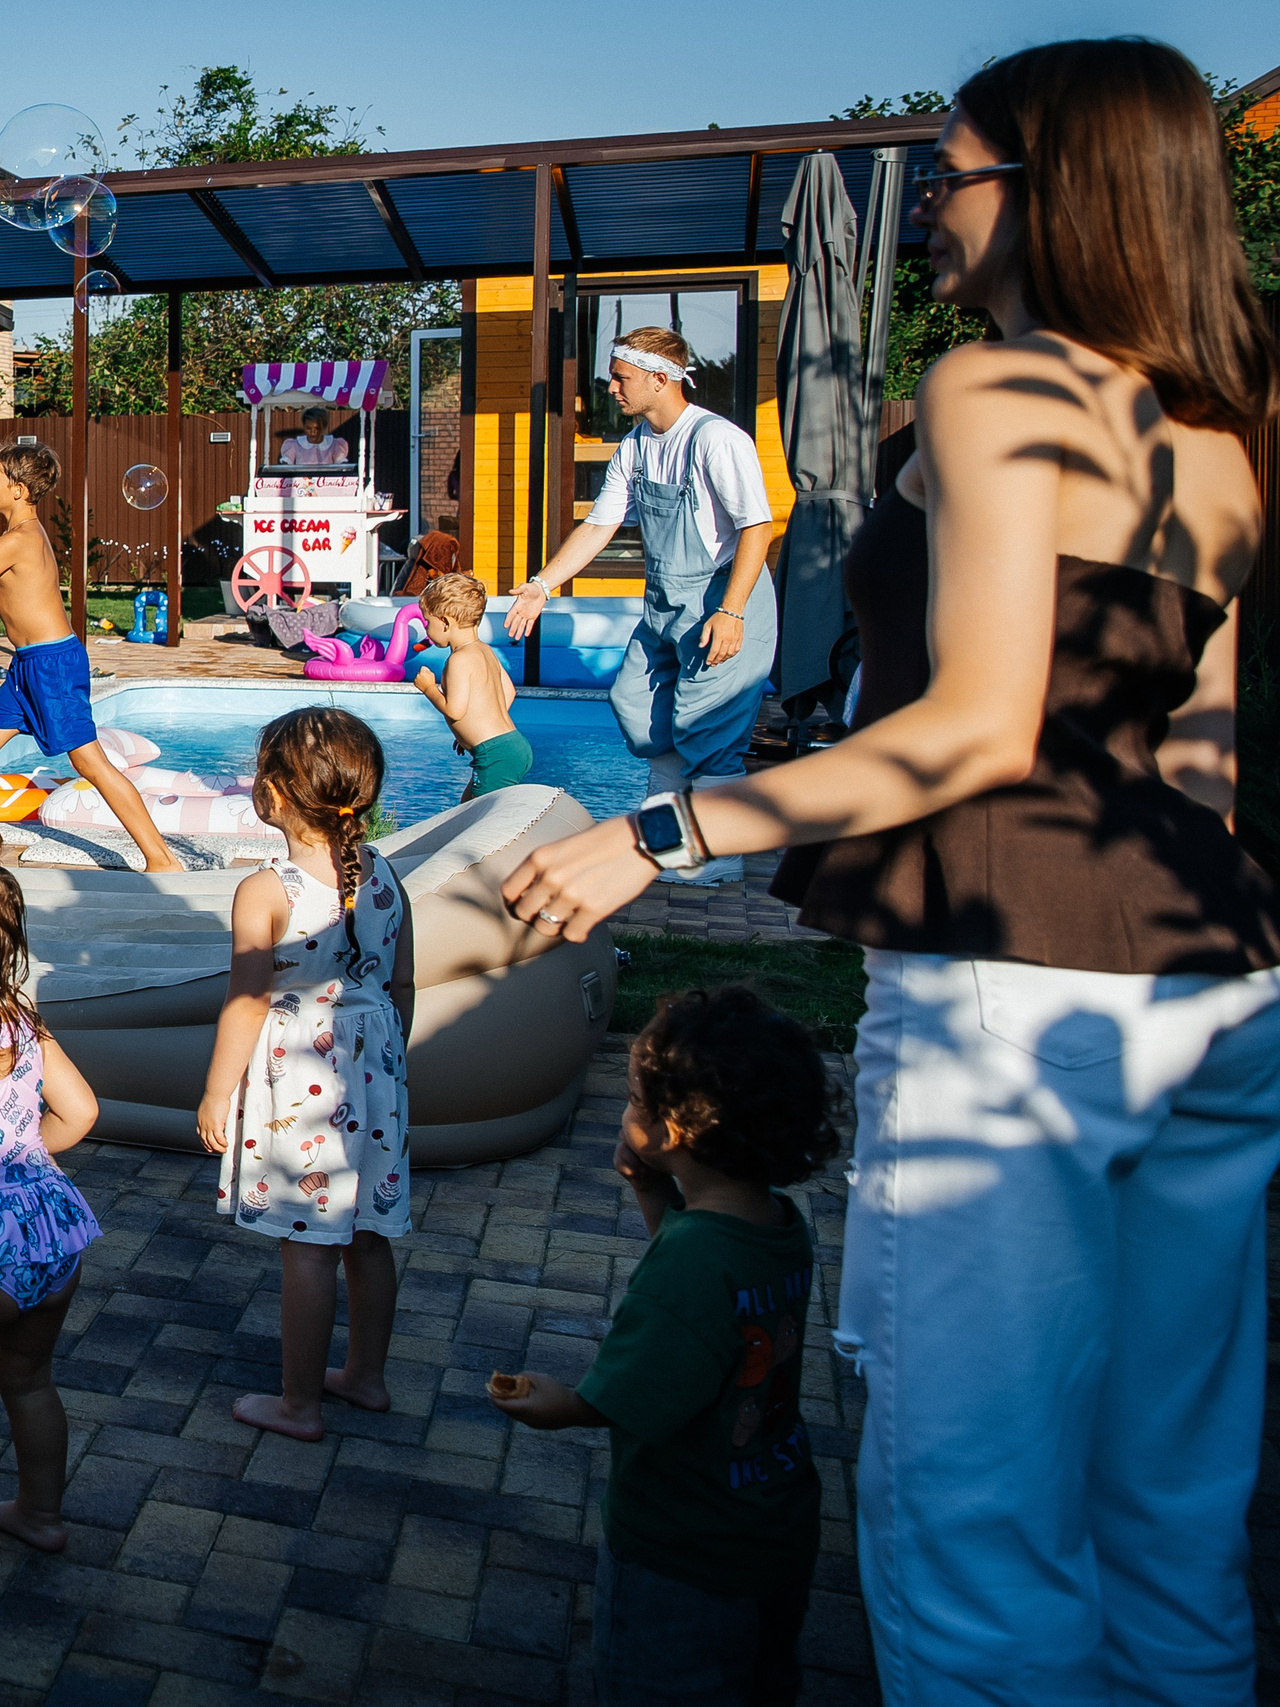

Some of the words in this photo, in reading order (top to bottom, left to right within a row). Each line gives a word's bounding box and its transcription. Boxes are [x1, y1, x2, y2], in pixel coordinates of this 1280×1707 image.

[253, 519, 275, 533] ICE
[280, 518, 330, 533] CREAM
[302, 537, 332, 552] BAR
